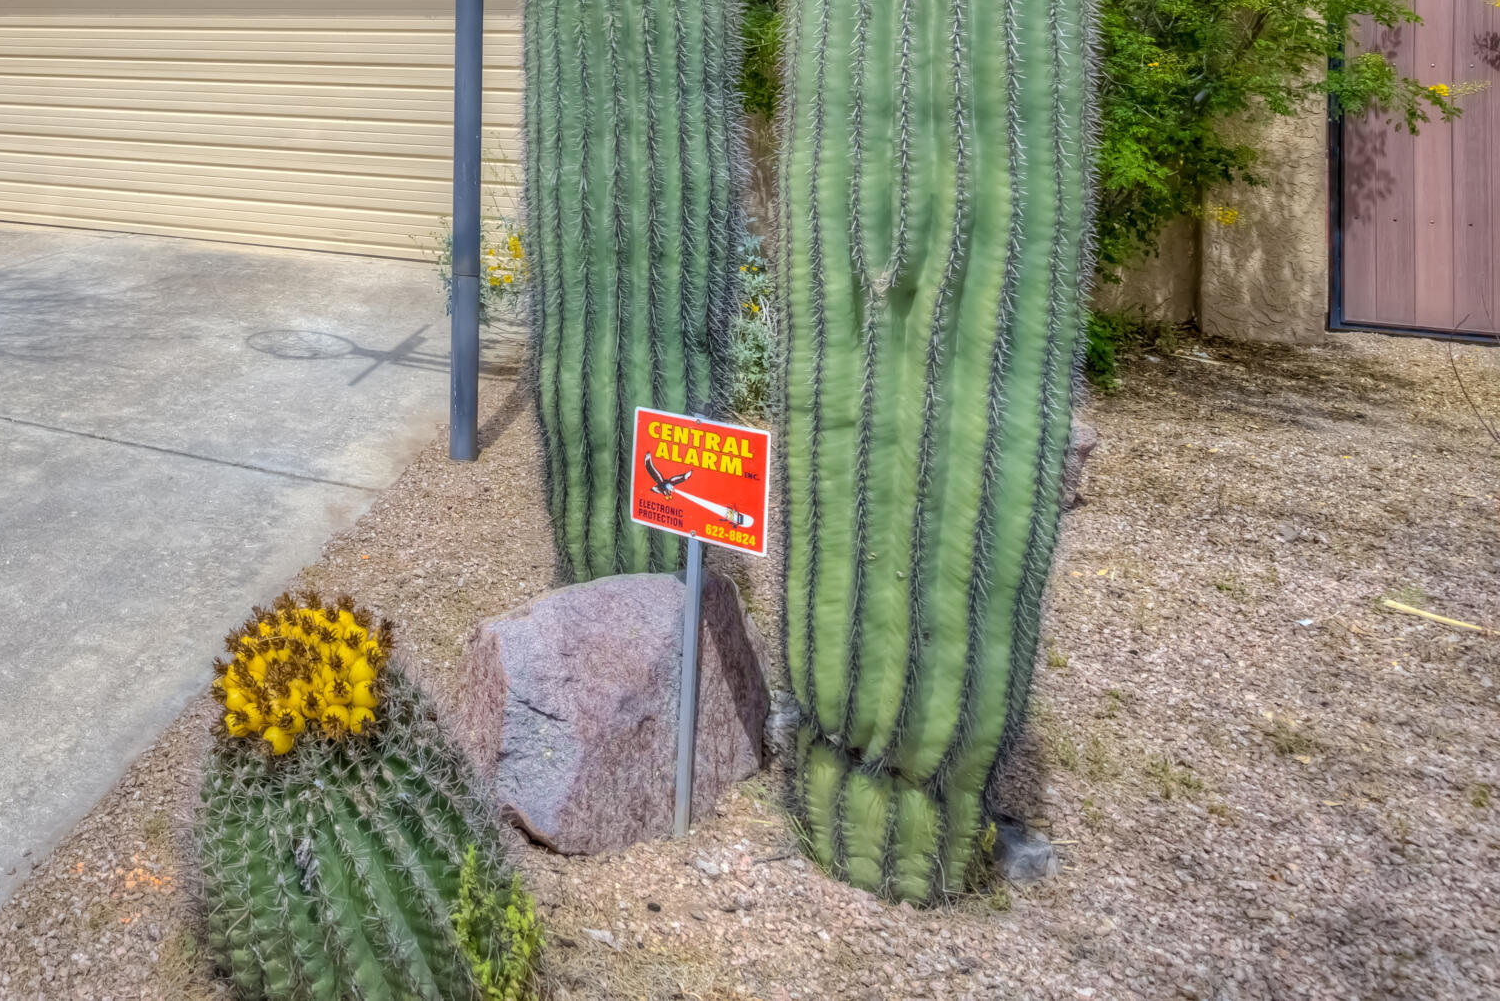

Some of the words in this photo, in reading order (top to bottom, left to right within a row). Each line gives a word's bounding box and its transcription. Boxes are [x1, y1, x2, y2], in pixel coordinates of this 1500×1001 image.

[648, 421, 753, 459] CENTRAL
[655, 441, 743, 476] ALARM
[638, 498, 684, 518] ELECTRONIC
[638, 508, 684, 528] PROTECTION
[705, 523, 756, 547] 622-8824
